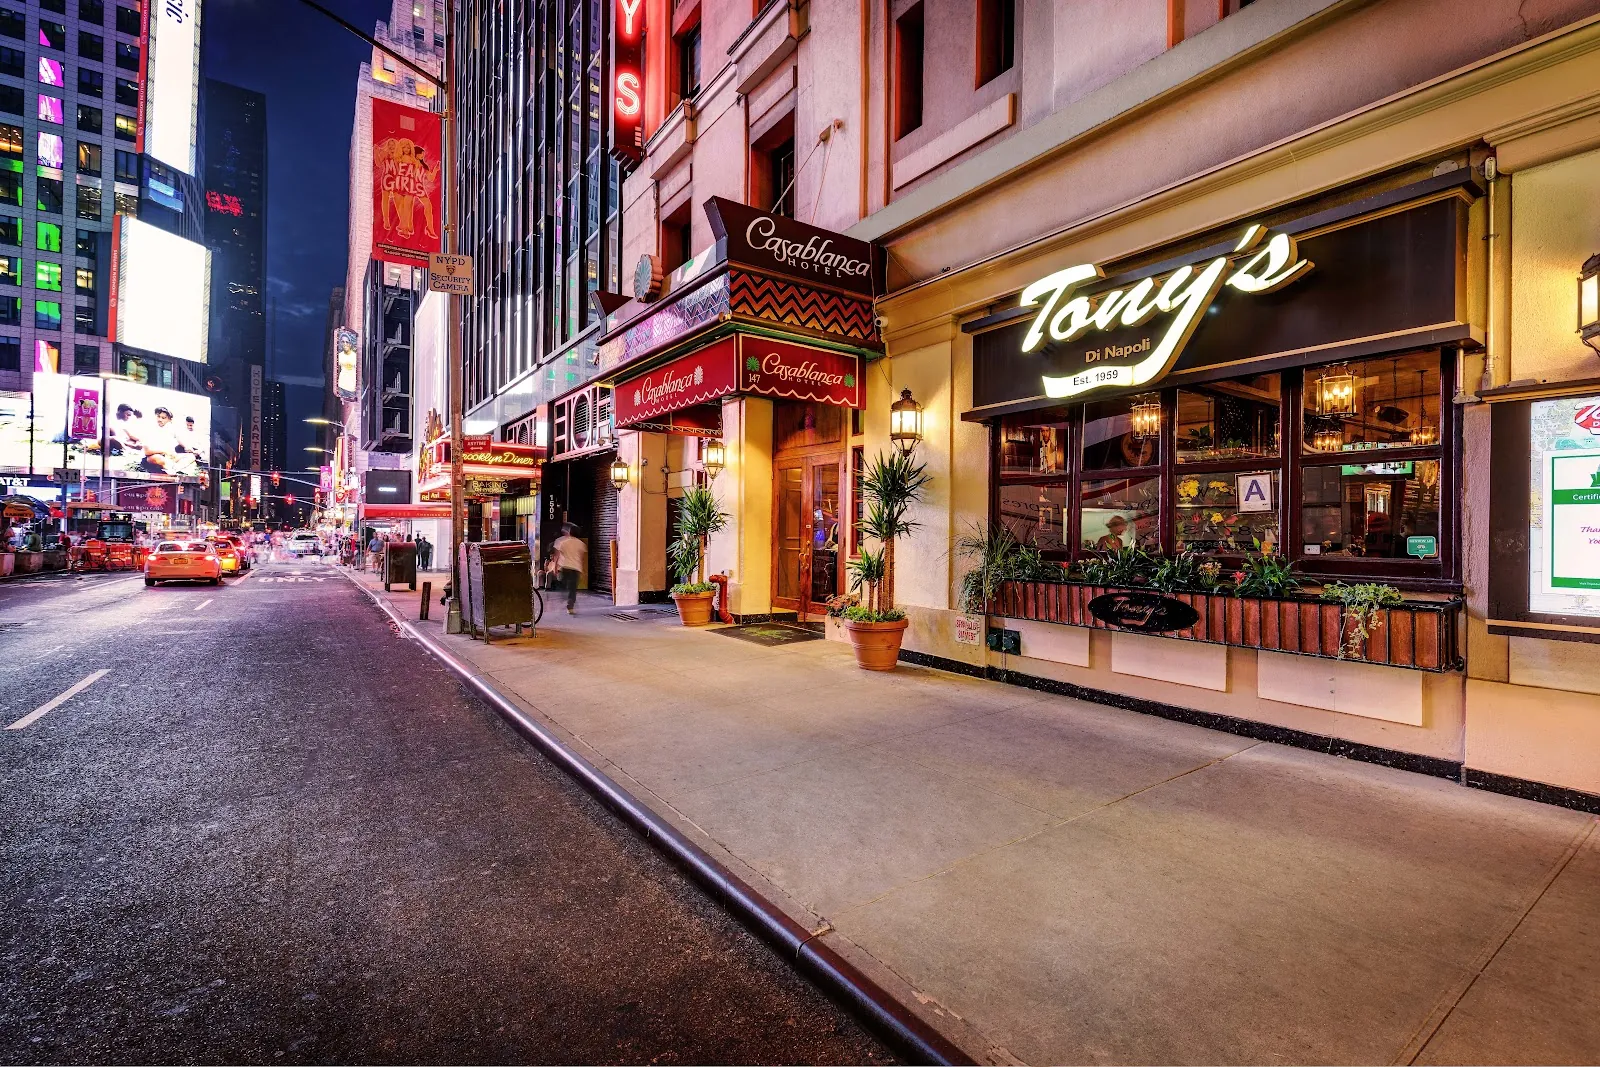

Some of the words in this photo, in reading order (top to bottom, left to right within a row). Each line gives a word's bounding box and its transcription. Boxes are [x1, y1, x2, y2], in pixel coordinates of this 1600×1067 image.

[384, 159, 425, 183] MEAN
[382, 173, 426, 197] GIRLS
[745, 216, 871, 277] Casablanca
[436, 255, 466, 266] NYPD
[787, 256, 841, 278] HOTEL
[430, 272, 471, 285] SECURITY
[433, 281, 469, 292] CAMERA
[1020, 224, 1314, 398] Tony's
[1085, 349, 1100, 363] Di
[1104, 338, 1151, 360] Napoli
[748, 373, 761, 384] 147
[761, 352, 843, 386] Casablanca
[1073, 377, 1092, 386] Est.
[1095, 369, 1119, 383] 1959
[252, 368, 261, 413] HOTEL
[641, 370, 694, 406] Casablanca
[788, 376, 822, 387] HOTEL
[251, 416, 260, 466] CARTER
[462, 452, 503, 465] rooklyn
[503, 451, 534, 465] Diner
[0, 476, 31, 487] AT&T
[472, 480, 509, 489] BAKING
[1244, 479, 1266, 502] A
